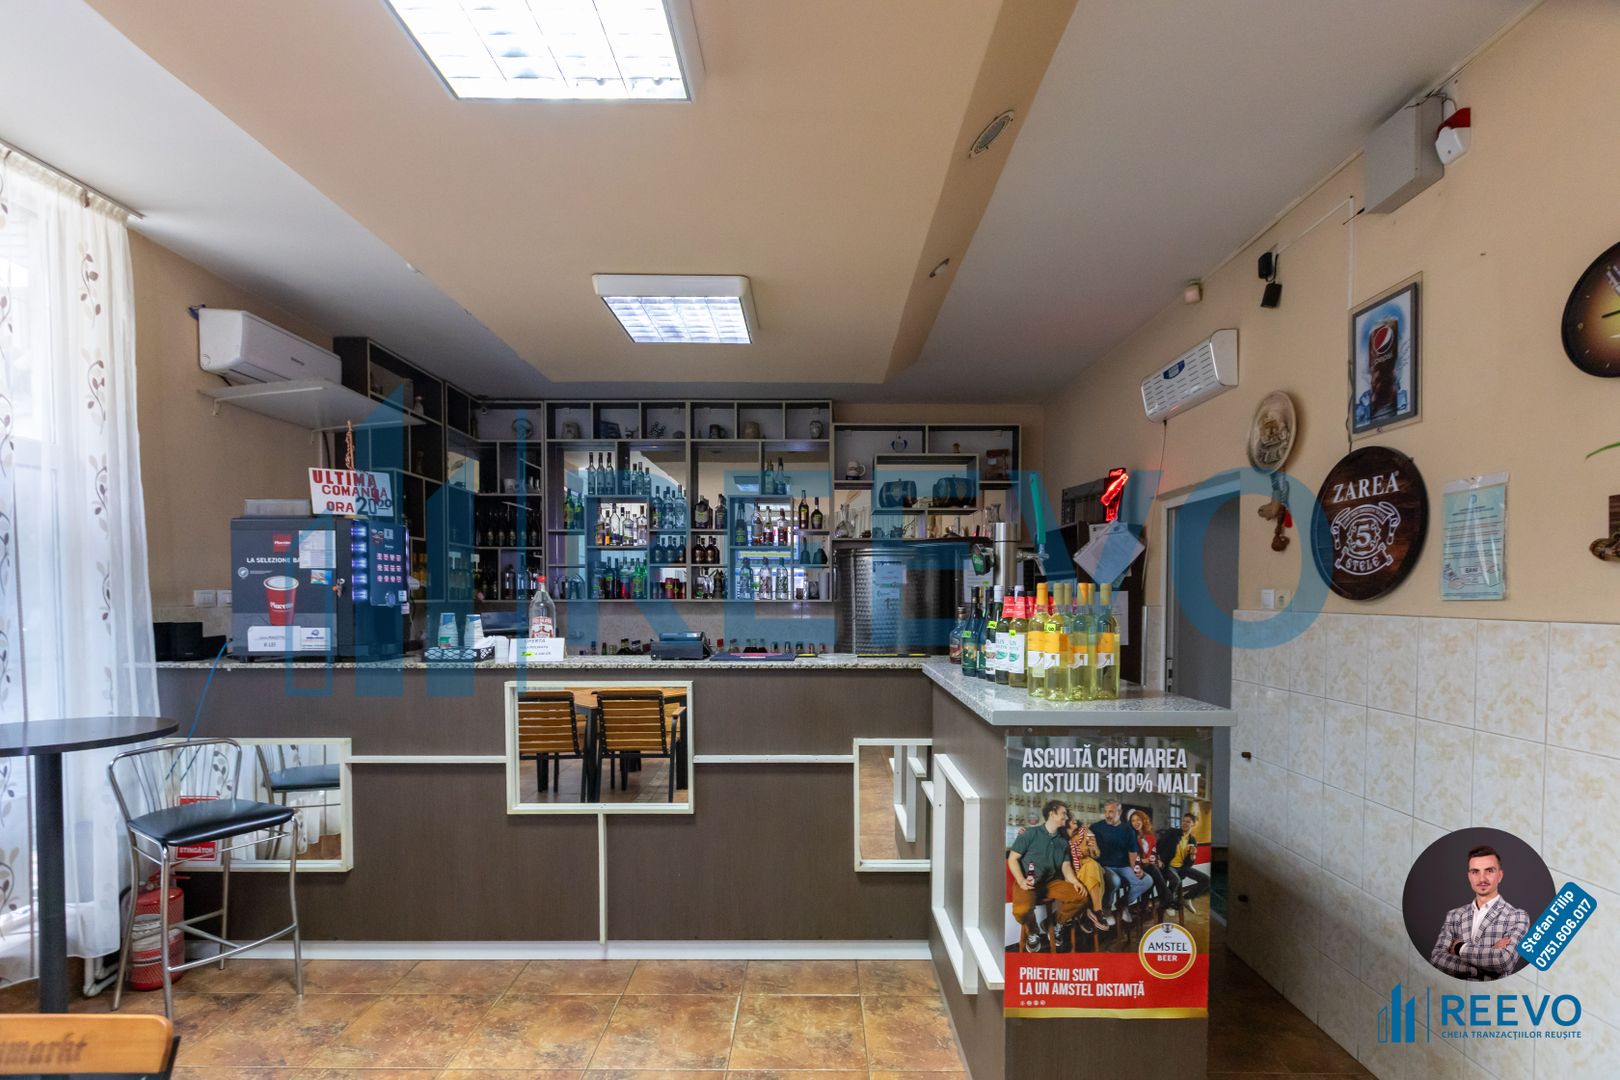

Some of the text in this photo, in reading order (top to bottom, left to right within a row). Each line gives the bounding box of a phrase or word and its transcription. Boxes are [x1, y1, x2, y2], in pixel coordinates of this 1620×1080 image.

[312, 469, 377, 488] ULTIMA
[321, 485, 388, 499] COMANDA
[1332, 471, 1400, 504] ZAREA
[326, 501, 355, 513] ORA
[1355, 524, 1371, 548] 5
[1345, 556, 1380, 571] STELE
[1022, 744, 1188, 769] ASCULTĂ CHEMAREA
[1022, 772, 1099, 793] GUSTULUI
[1106, 772, 1153, 793] 100%
[1148, 941, 1188, 952] AMSTEL
[1157, 954, 1178, 962] BEER
[1019, 967, 1100, 981] PRIETENII SUNT
[1019, 981, 1145, 999] LA UN AMSTEL DISTANȚĂ
